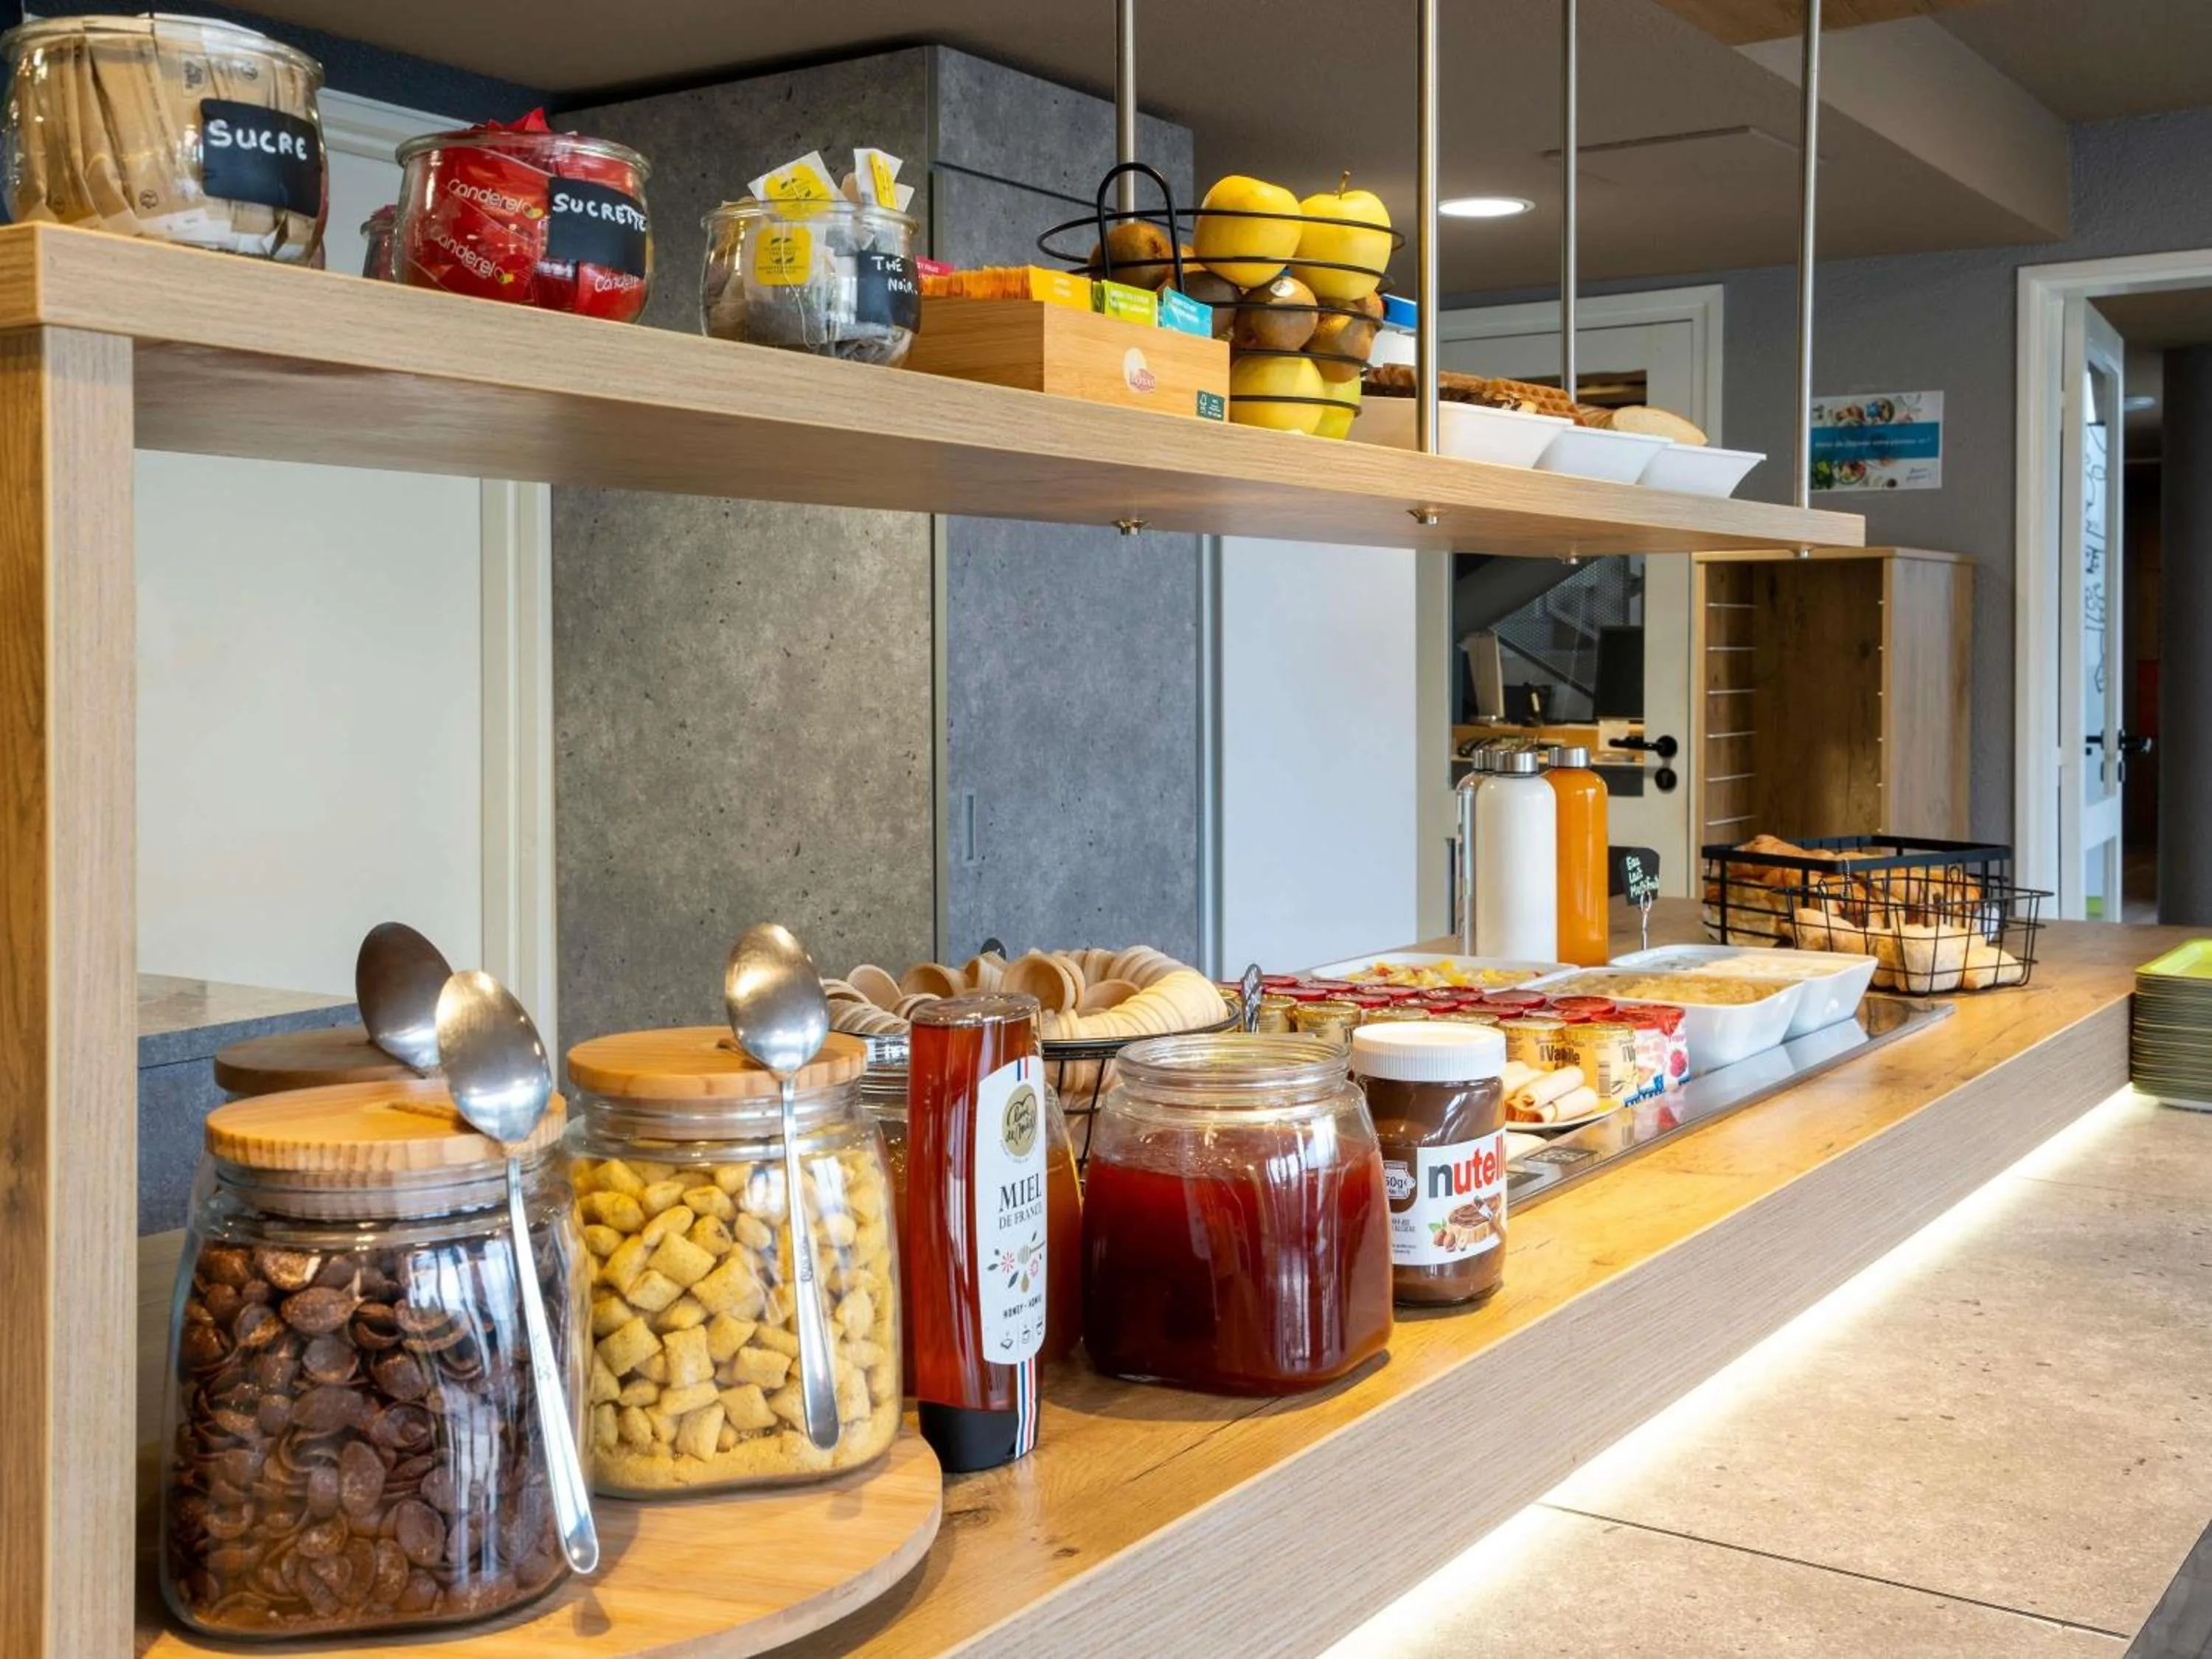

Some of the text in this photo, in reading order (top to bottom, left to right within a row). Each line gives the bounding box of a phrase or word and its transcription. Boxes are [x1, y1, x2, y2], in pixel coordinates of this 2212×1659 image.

[208, 118, 307, 161] SUCRE
[1427, 1132, 1506, 1199] nutell
[999, 1173, 1042, 1212] MIEL
[999, 1214, 1012, 1230] DE
